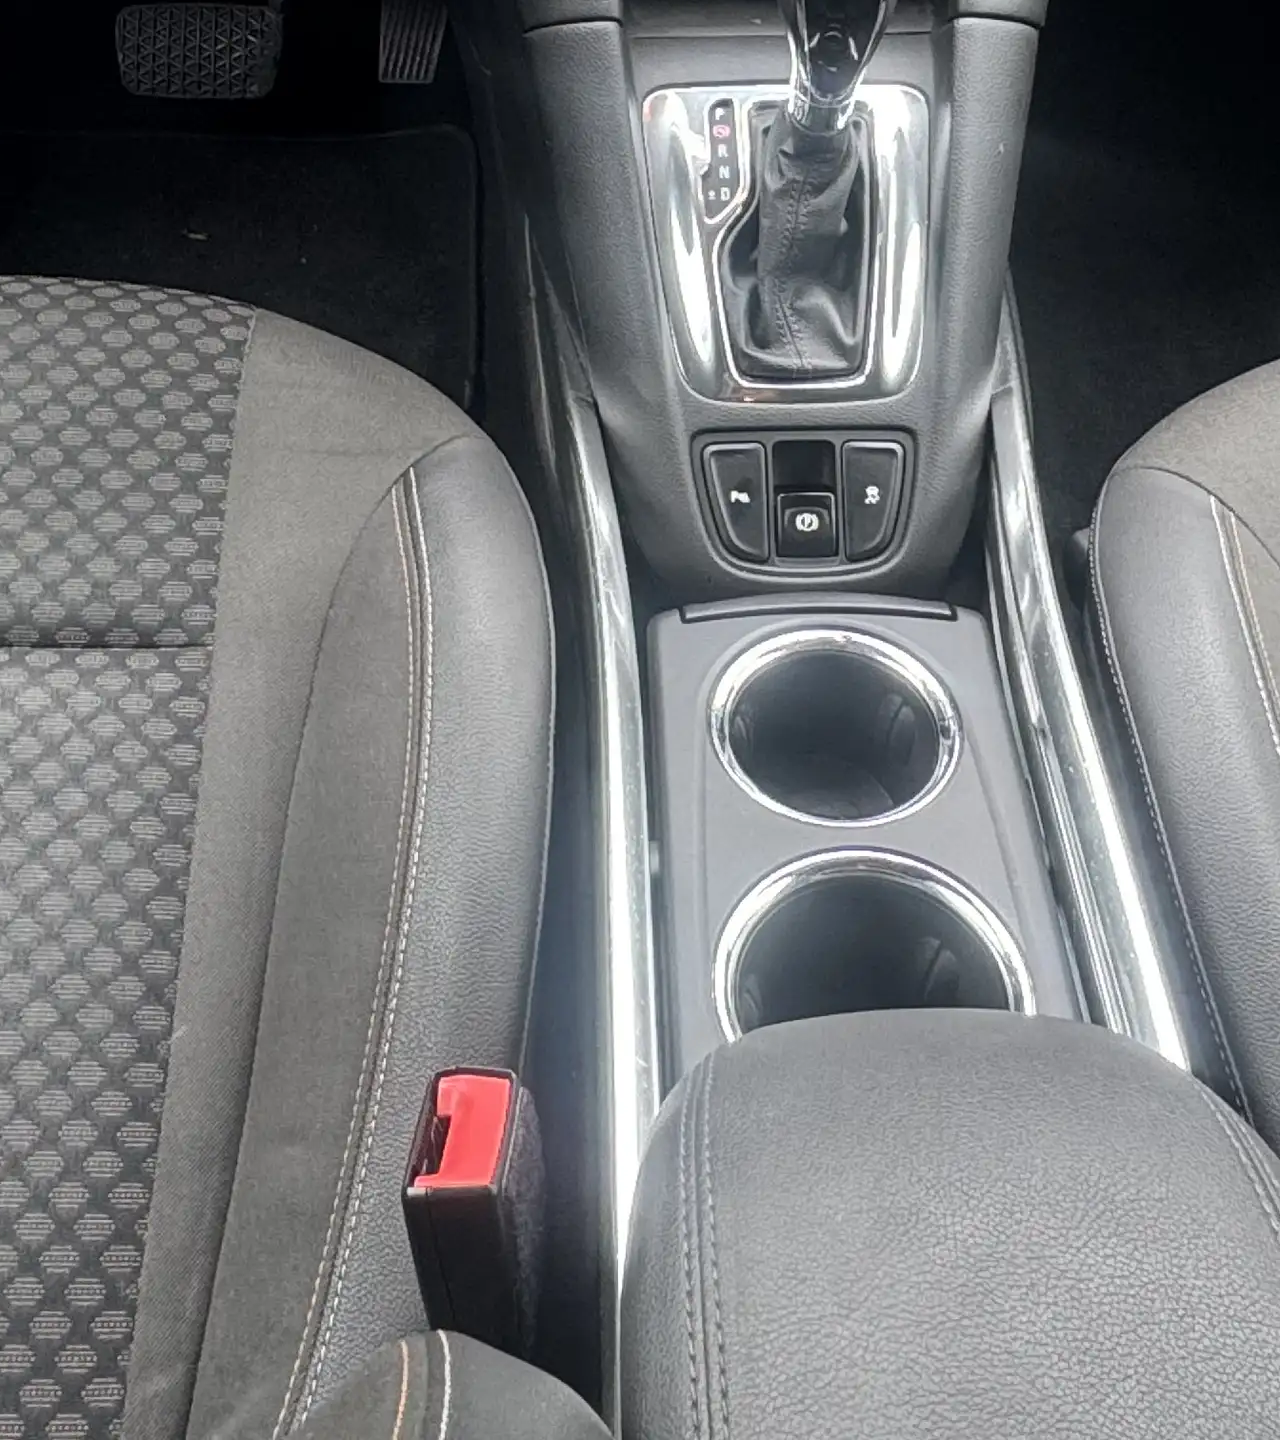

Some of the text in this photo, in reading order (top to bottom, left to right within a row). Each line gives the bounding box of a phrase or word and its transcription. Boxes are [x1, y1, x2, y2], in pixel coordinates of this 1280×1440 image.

[715, 107, 726, 120] P
[718, 143, 728, 158] R
[719, 165, 730, 179] N
[720, 187, 731, 201] D
